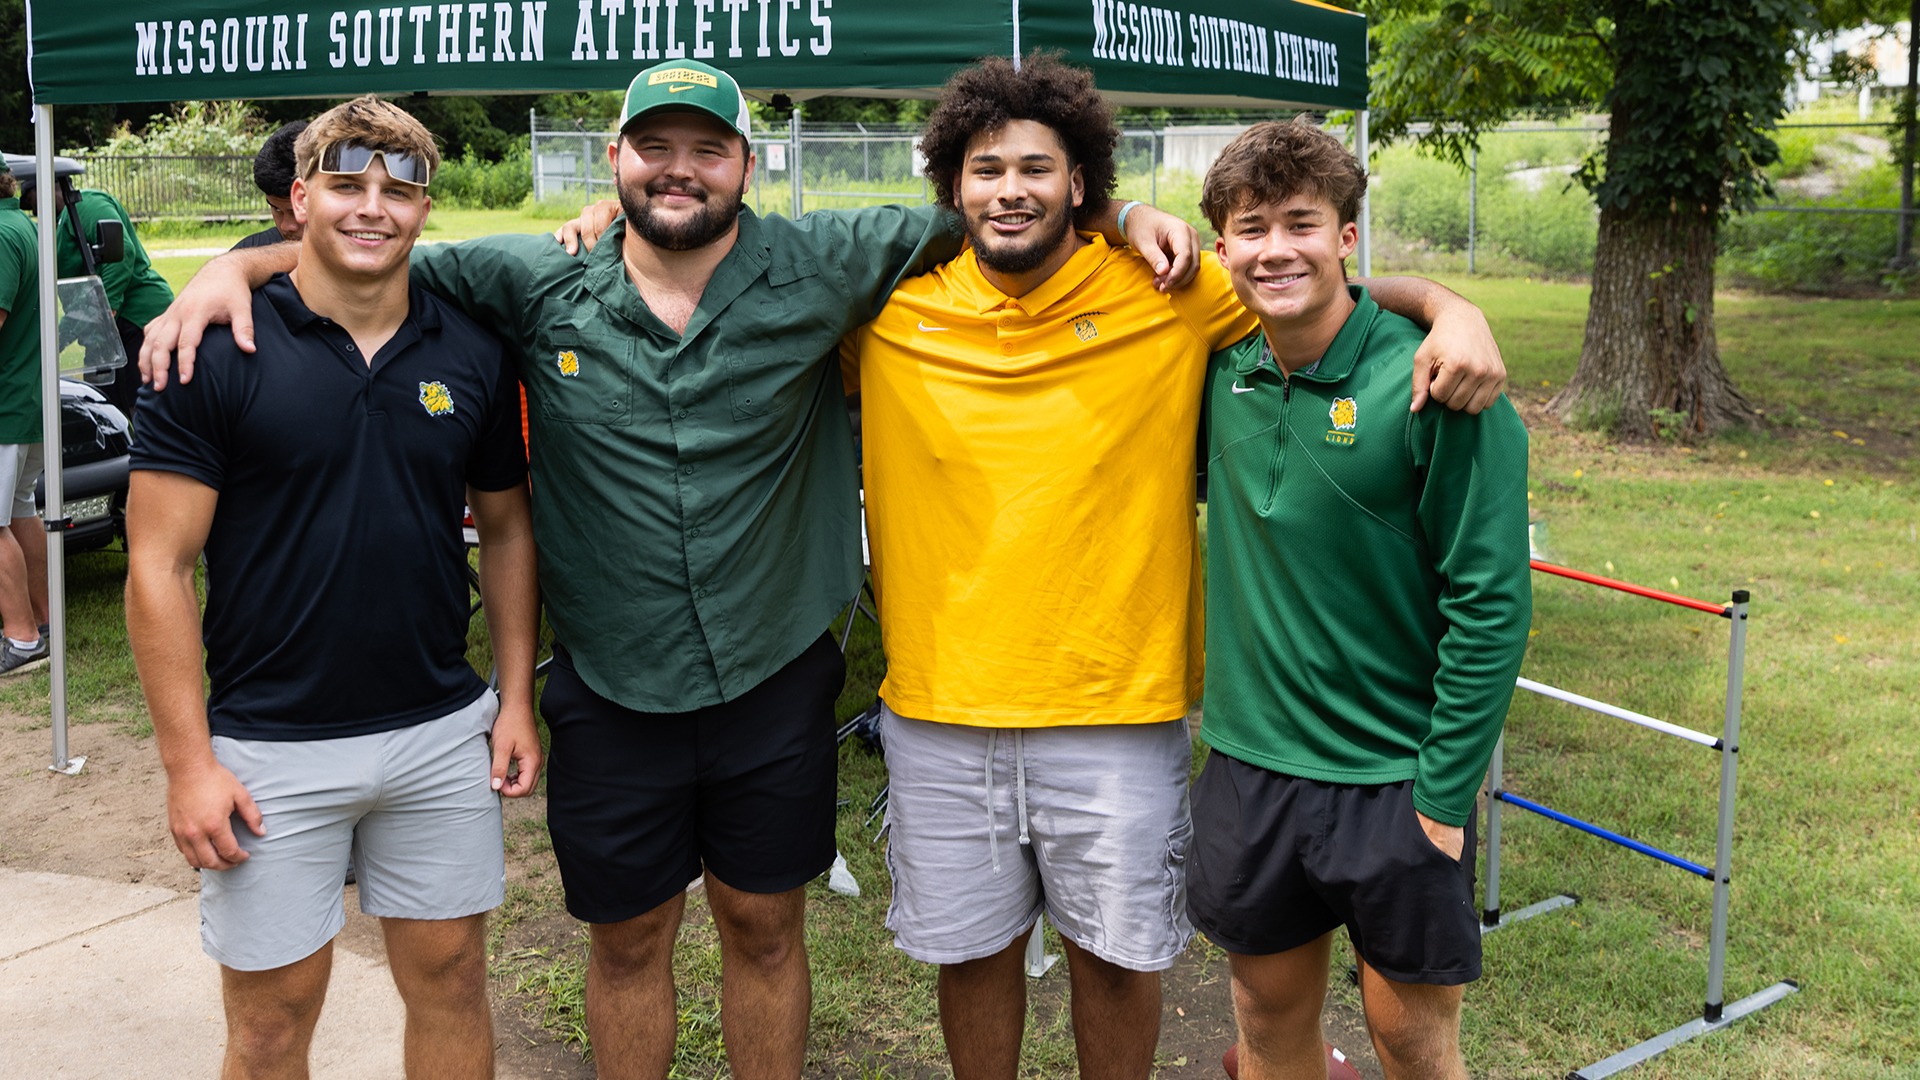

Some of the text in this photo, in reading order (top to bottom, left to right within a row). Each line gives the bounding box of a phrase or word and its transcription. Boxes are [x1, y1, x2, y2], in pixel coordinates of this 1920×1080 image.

[135, 0, 832, 75] MISSOURI SOUTHERN ATHLETICS
[1092, 0, 1339, 87] MISSOURI SOUTHERN ATHLETICS
